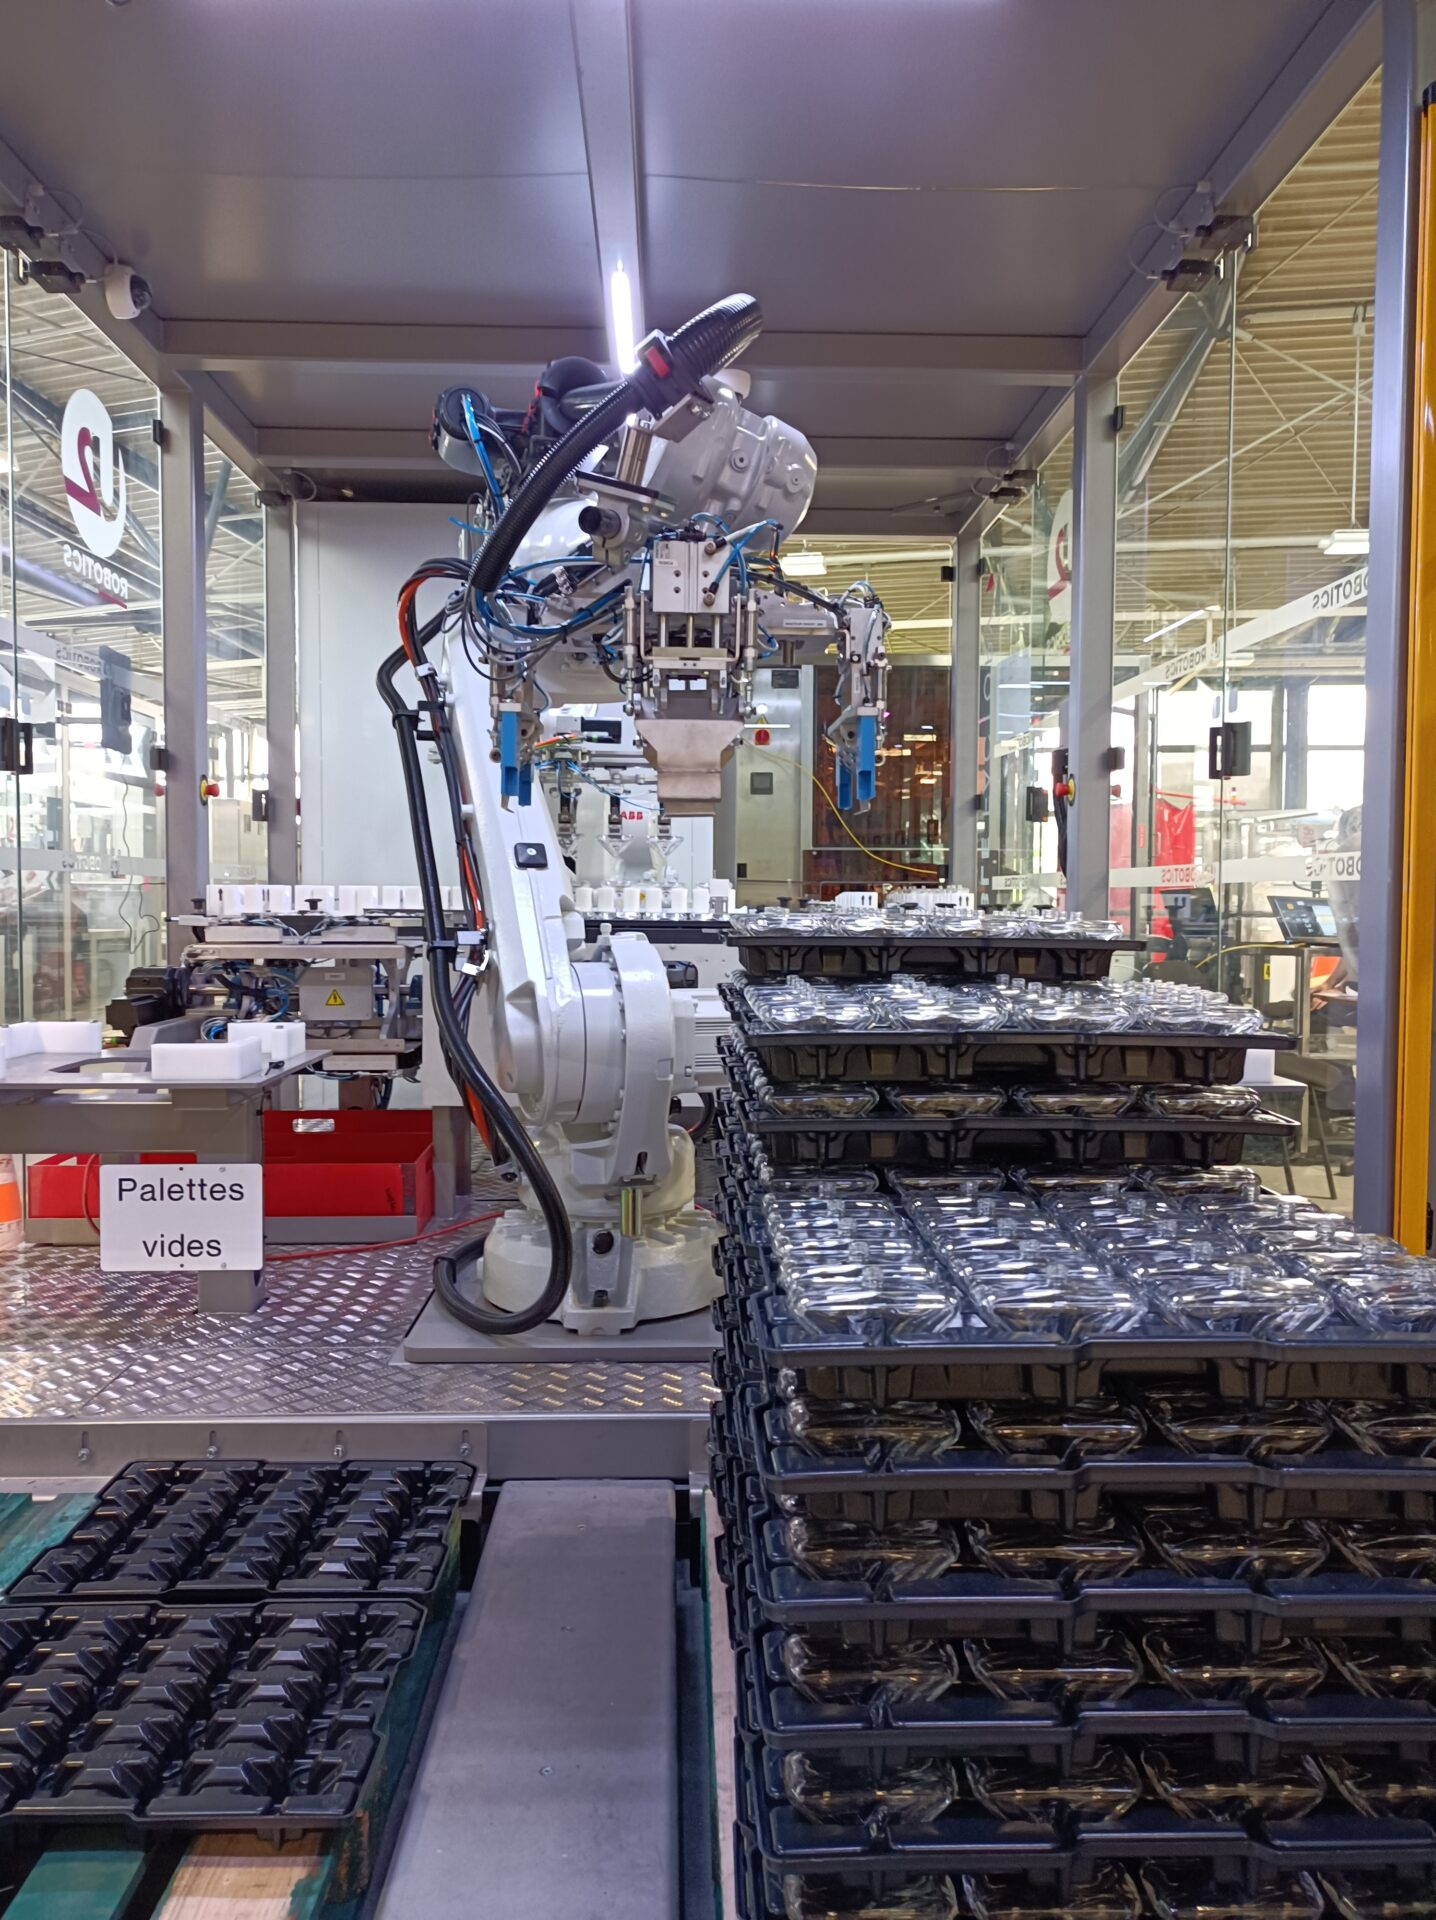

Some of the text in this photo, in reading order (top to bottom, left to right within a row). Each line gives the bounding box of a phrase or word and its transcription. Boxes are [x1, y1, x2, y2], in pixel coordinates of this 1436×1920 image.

[621, 811, 644, 820] ABB
[117, 1177, 245, 1202] Palettes
[142, 1234, 222, 1258] vides
